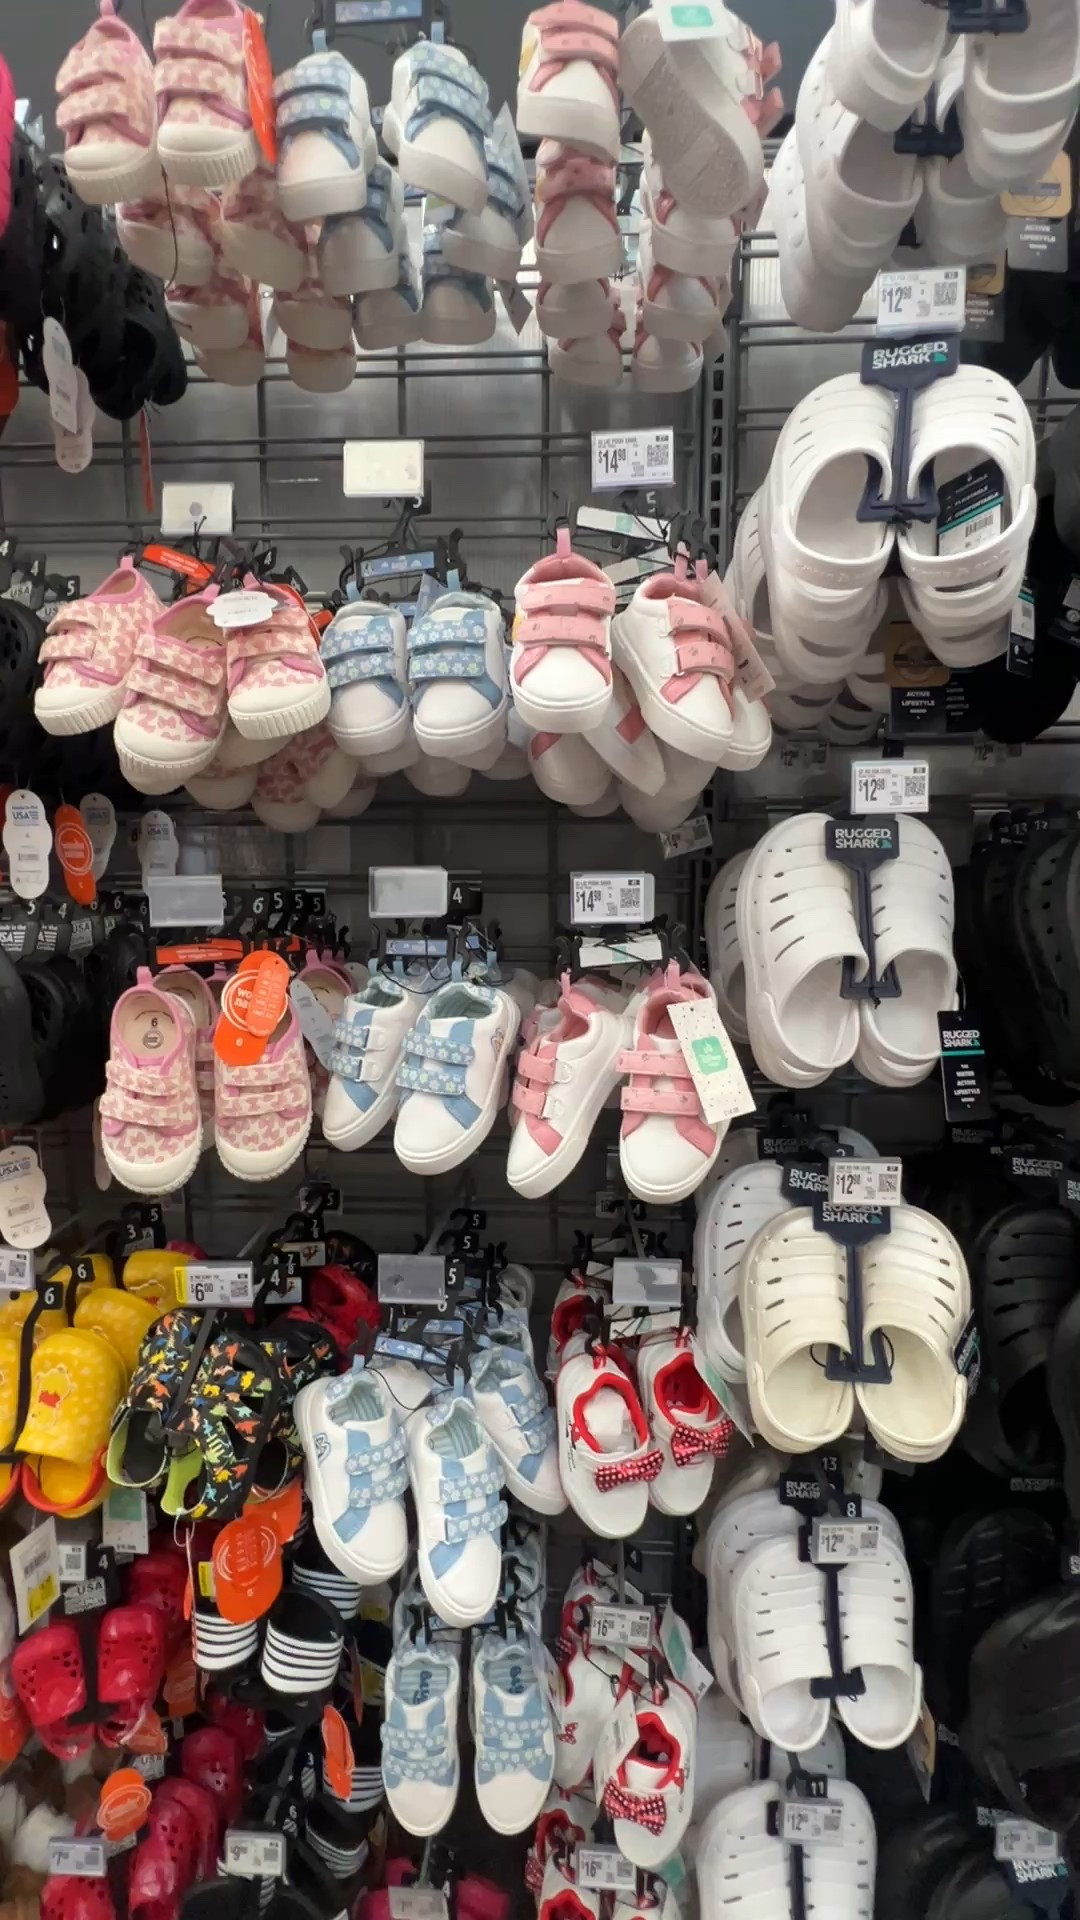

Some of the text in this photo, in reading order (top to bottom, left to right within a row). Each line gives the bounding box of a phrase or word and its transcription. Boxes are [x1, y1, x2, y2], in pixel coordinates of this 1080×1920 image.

[873, 341, 948, 359] RUGGED
[872, 352, 930, 370] SHARK
[0, 540, 10, 556] 4
[30, 560, 39, 577] 4
[66, 580, 76, 597] 5
[12, 811, 30, 820] USA
[834, 828, 892, 839] RUGGED
[835, 838, 880, 849] SHARK
[114, 895, 122, 910] 6
[273, 892, 283, 909] 5
[295, 893, 303, 909] 5
[452, 887, 463, 904] 4
[58, 903, 68, 919] 4
[252, 897, 264, 914] 6
[313, 897, 321, 912] 5
[151, 1017, 158, 1028] 6
[235, 1037, 243, 1047] 6
[942, 1029, 980, 1040] RUGGED
[943, 1039, 972, 1048] SHARK
[1011, 1157, 1063, 1171] RUGGED
[1012, 1166, 1052, 1177] SHARK
[790, 1168, 828, 1183] RUGG
[150, 1208, 158, 1222] 5
[822, 1201, 882, 1214] RUGGED
[471, 1214, 480, 1227] 5
[822, 1211, 869, 1223] SHARK
[126, 1224, 137, 1239] 3
[462, 1236, 471, 1250] 5
[76, 1264, 87, 1279] 6
[270, 1269, 281, 1287] 4
[447, 1267, 457, 1285] 5
[44, 1287, 55, 1305] 6
[822, 1456, 838, 1471] 13
[786, 1480, 821, 1490] RUGG
[786, 1489, 820, 1498] SHAR
[846, 1502, 857, 1517] 8
[77, 1581, 104, 1595] USA
